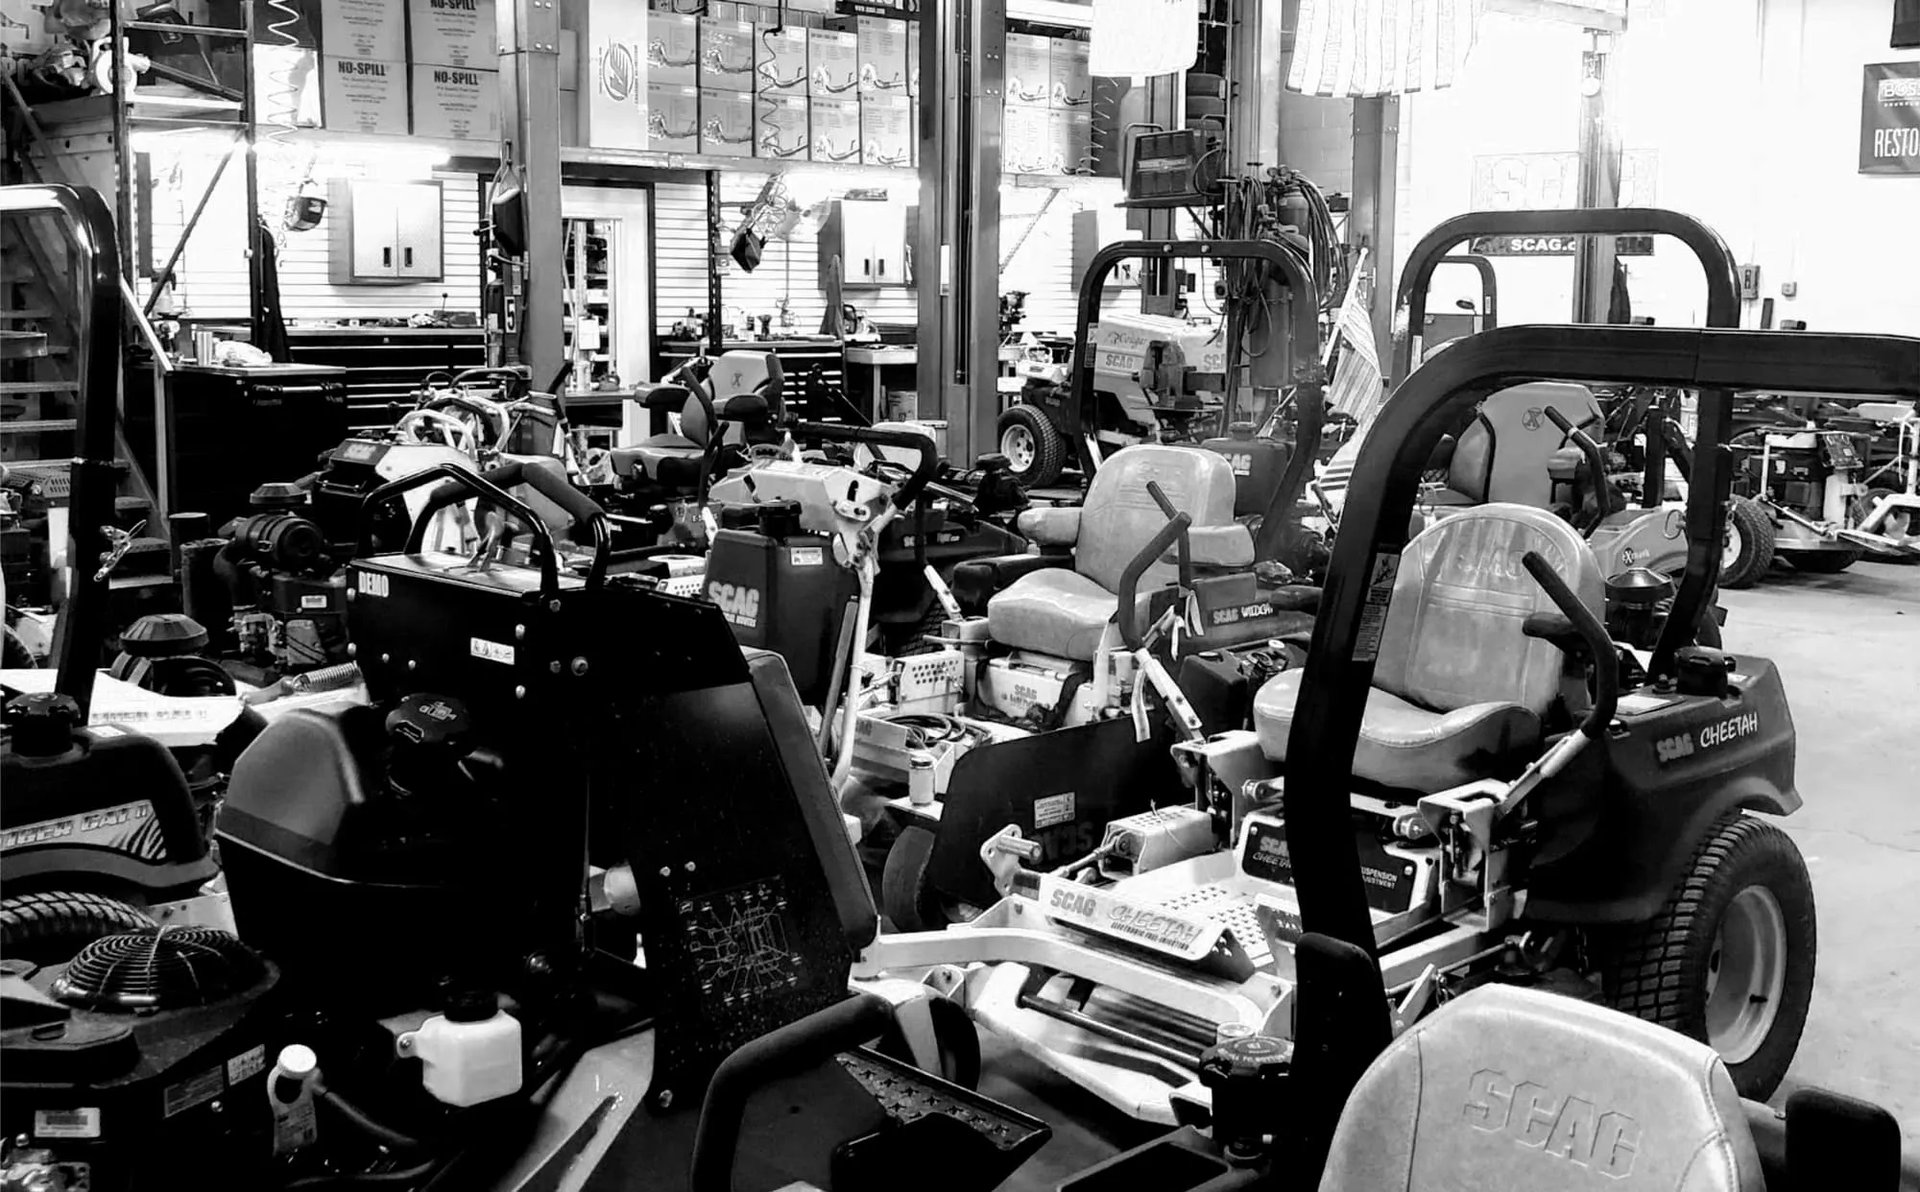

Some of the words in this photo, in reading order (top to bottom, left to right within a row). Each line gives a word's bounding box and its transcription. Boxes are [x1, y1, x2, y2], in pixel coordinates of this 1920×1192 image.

[431, 0, 476, 10] NO-SPILL
[338, 61, 386, 76] NO-SPILL
[434, 70, 479, 85] NO-SPILL
[1874, 127, 1920, 157] RESTO
[1106, 354, 1133, 369] SCAG
[358, 571, 389, 598] DEMO
[708, 580, 760, 618] SCAG
[1213, 608, 1239, 624] SCAG
[1656, 732, 1695, 762] SCAG
[1700, 711, 1759, 748] CHEETAH
[1050, 888, 1096, 917] SCAG
[1106, 905, 1204, 944] CHEETAH
[1462, 1068, 1642, 1180] SCAG
